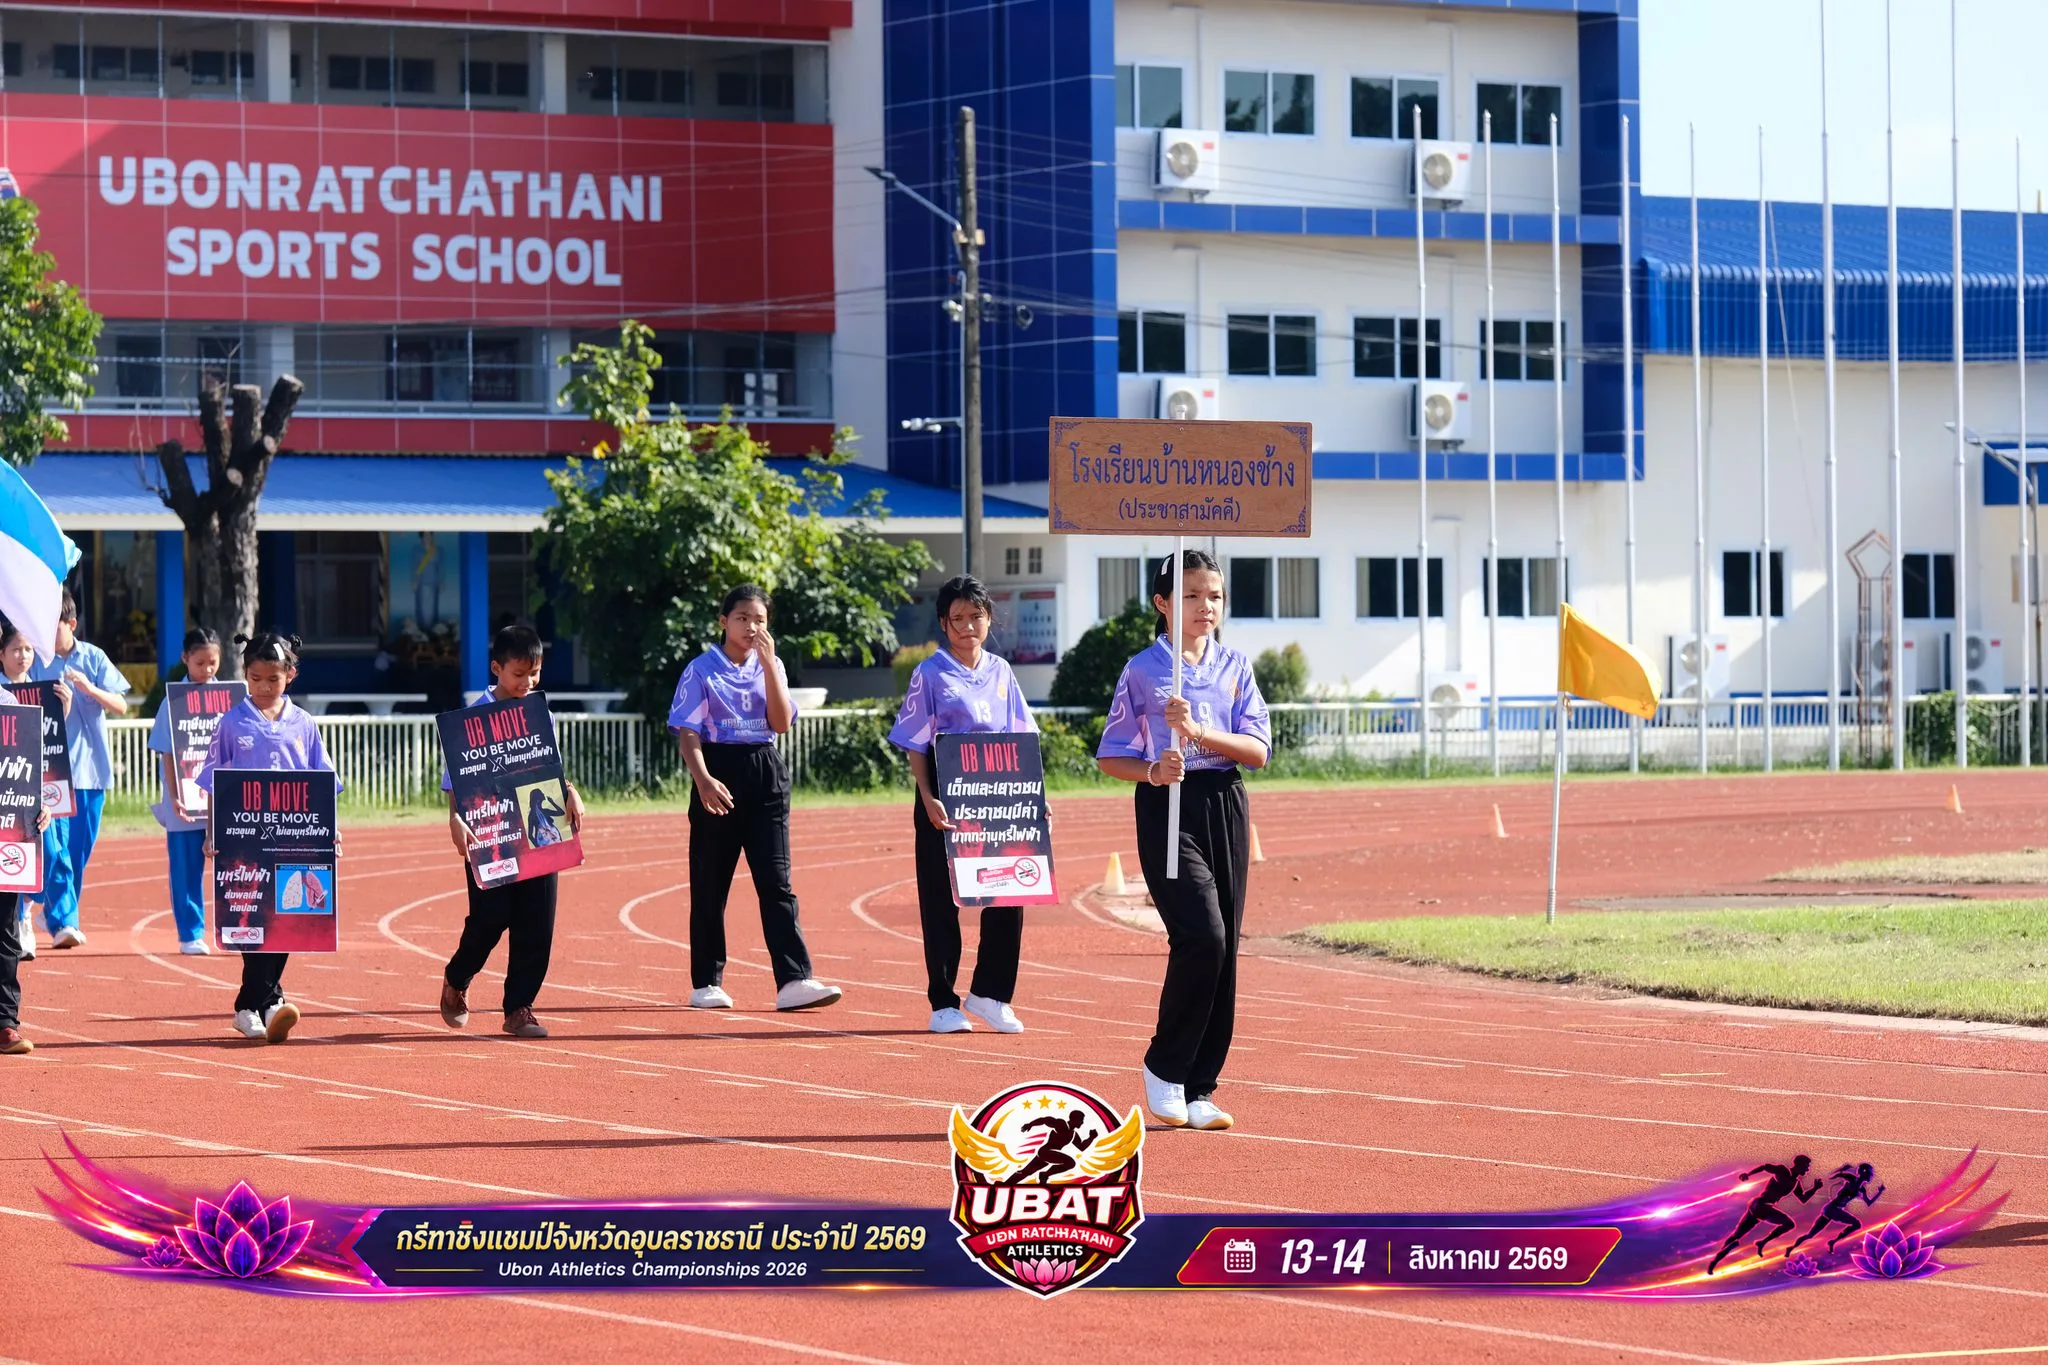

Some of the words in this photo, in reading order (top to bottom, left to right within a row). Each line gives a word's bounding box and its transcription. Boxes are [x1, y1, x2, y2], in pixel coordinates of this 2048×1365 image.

[98, 155, 663, 222] UBONRATCHATHANI
[166, 226, 381, 280] SPORTS
[412, 233, 621, 287] SCHOOL
[1069, 442, 1295, 488] โรงเรียนบ้านหนองช้าง
[1118, 496, 1241, 524] (ประชาสามัคคี)
[973, 700, 992, 723] 13
[1198, 701, 1214, 727] 9
[464, 717, 486, 748] UB
[489, 706, 530, 743] MOVE
[461, 746, 488, 762] YOU
[490, 742, 505, 756] BE
[506, 734, 542, 752] MOVE
[960, 743, 979, 773] UB
[984, 743, 1020, 773] MOVE
[243, 781, 262, 812] UB
[269, 781, 309, 812] MOVE
[947, 777, 1042, 797] เด็กและเยาวชน
[232, 812, 260, 823] YOU
[263, 812, 279, 824] BE
[282, 813, 320, 824] MOVE
[954, 800, 1038, 821] ประชาชนมีค่า
[951, 824, 1041, 848] มากกว่าบุหรี่ไฟฟ้า
[216, 865, 271, 887] บุหรี่ไฟฟ้า
